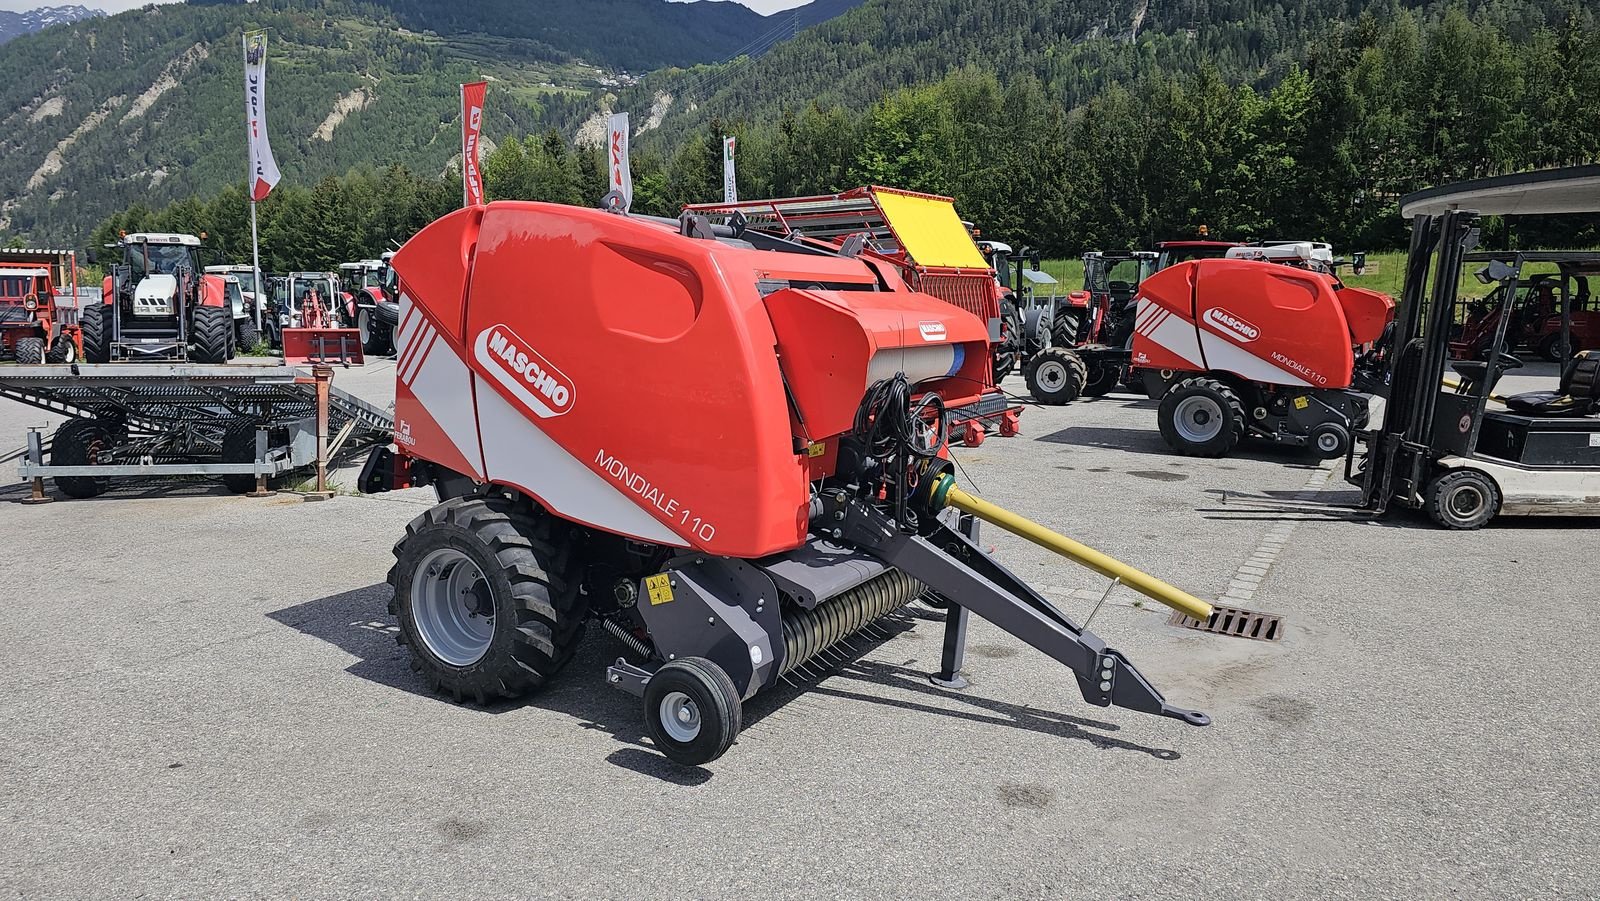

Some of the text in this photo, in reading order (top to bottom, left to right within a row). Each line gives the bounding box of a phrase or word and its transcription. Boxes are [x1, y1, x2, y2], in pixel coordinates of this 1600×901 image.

[1211, 309, 1258, 339] MASCHIO
[488, 329, 570, 408] MASCHIO
[1270, 351, 1327, 385] MONDIALE 110
[594, 448, 716, 543] MONDIALE 110
